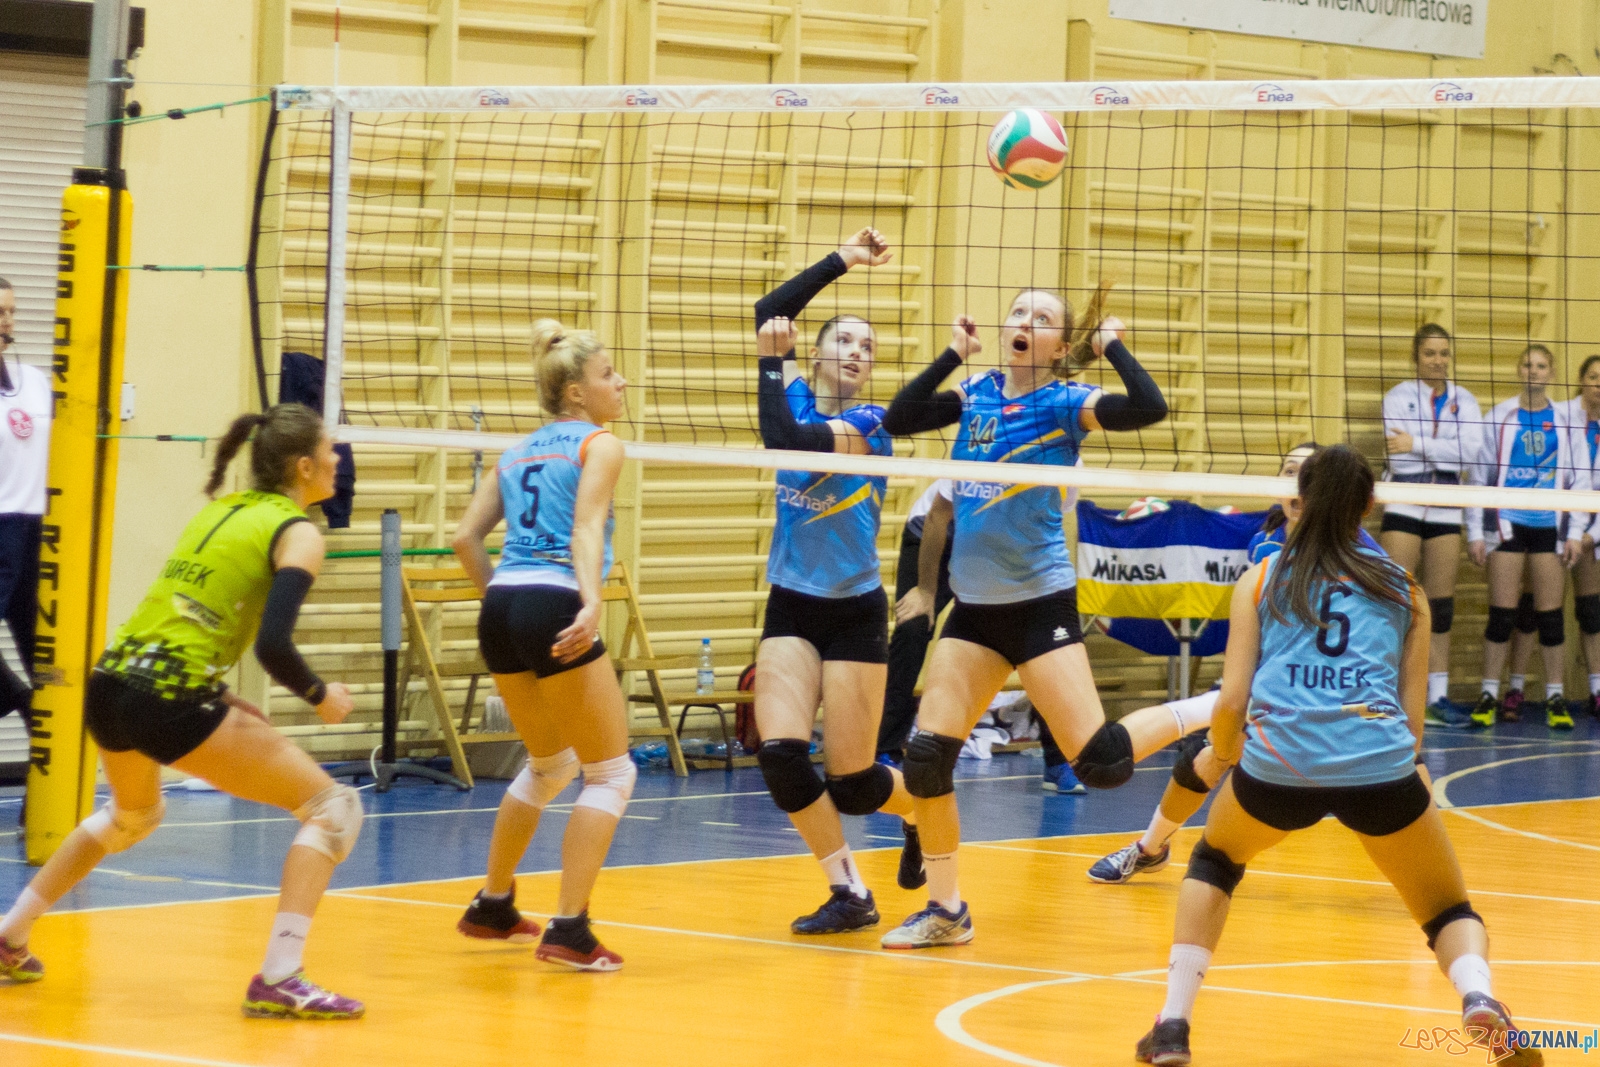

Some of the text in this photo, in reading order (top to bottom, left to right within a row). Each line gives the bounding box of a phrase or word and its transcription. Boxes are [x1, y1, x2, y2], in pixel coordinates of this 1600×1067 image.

[480, 95, 509, 106] Enea
[626, 94, 658, 106] Enea
[775, 95, 808, 107] Enea
[925, 93, 959, 105] Enea
[1094, 93, 1129, 105] Enea
[1257, 90, 1294, 102] Enea
[1434, 89, 1473, 101] Enea
[519, 463, 545, 529] 5
[194, 503, 248, 554] 1
[1316, 585, 1353, 658] 6
[1286, 663, 1372, 690] TUREK
